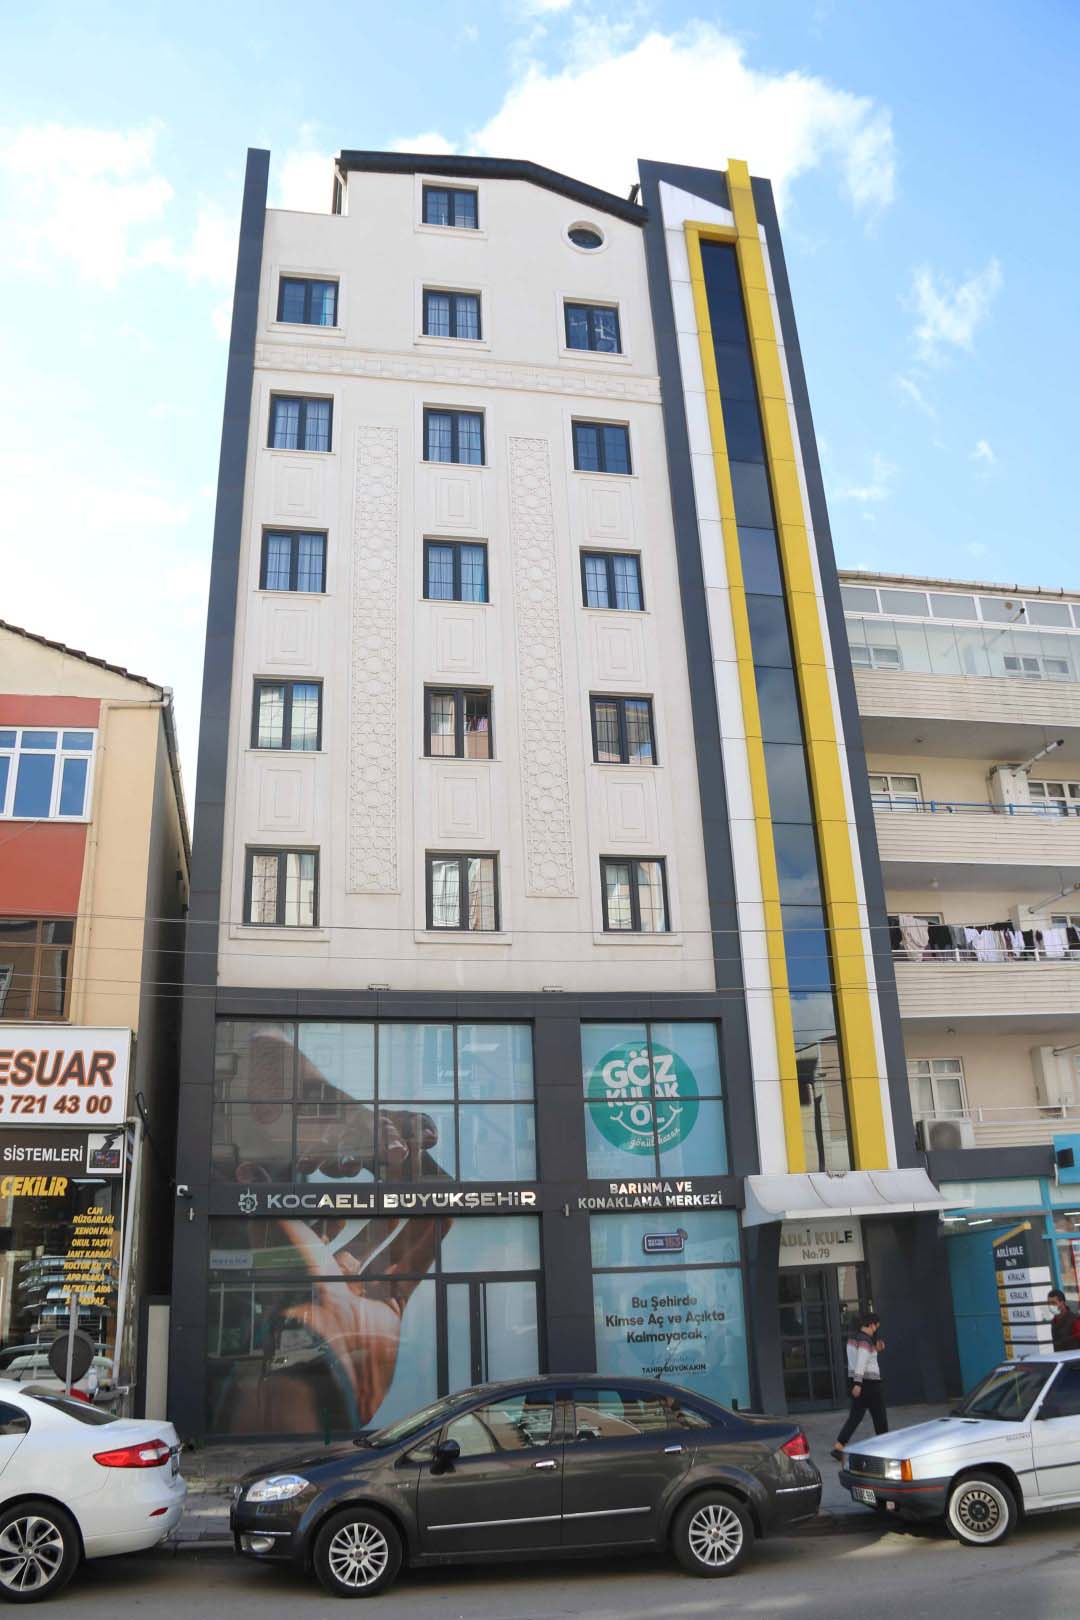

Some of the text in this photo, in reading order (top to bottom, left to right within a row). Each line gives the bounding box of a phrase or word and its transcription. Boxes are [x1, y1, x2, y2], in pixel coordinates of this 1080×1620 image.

[602, 1050, 677, 1088] GÖZ
[10, 1094, 48, 1114] 721
[53, 1094, 81, 1114] 43
[86, 1095, 113, 1114] 00
[3, 1144, 83, 1161] SİSTEMLERİ
[609, 1181, 693, 1195] BARINMA VE
[383, 1191, 537, 1209] BÜYÜKŞEHİR
[578, 1191, 723, 1209] KONAKLAMA MERKEZİ
[632, 1295, 697, 1311] Bu Şehirde
[605, 1310, 726, 1328] Kimse Aç ve Açıkta
